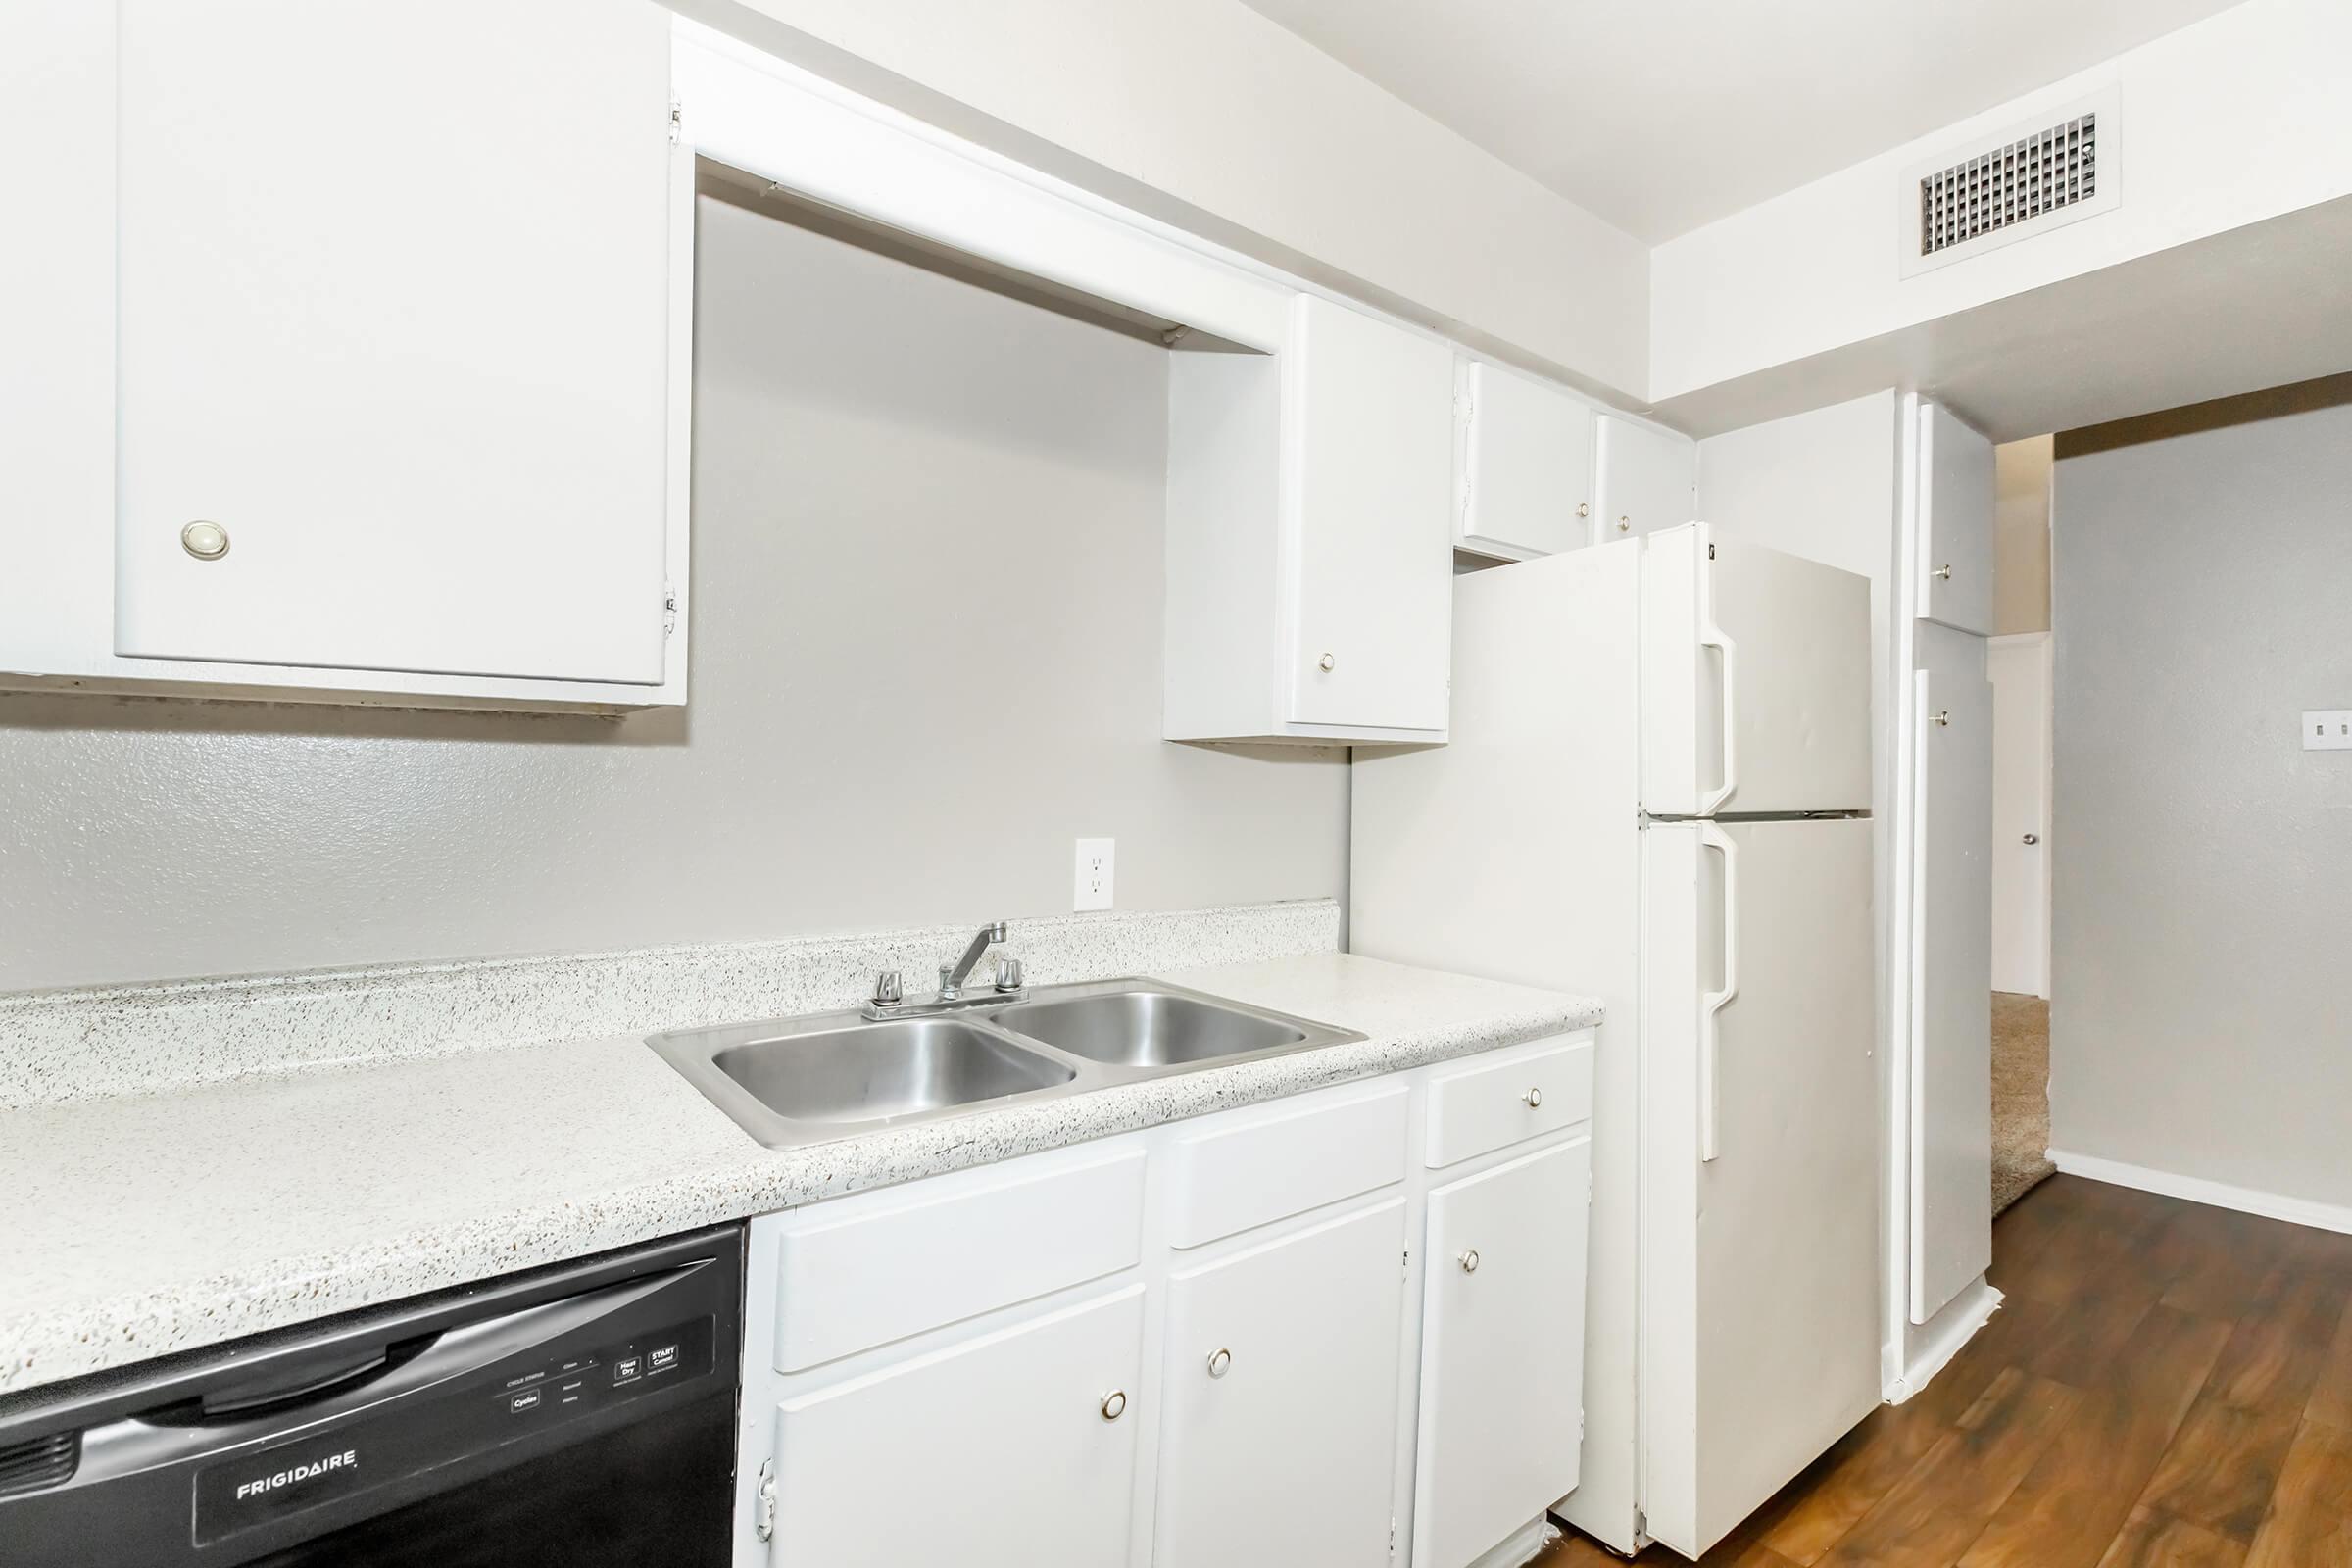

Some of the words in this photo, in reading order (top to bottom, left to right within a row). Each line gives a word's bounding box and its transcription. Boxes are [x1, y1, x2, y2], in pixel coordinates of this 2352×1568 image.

[652, 1347, 675, 1360] START
[620, 1360, 636, 1370] Heat
[514, 1396, 537, 1407] Cycles
[237, 1450, 356, 1499] FRIGIDAIRE
